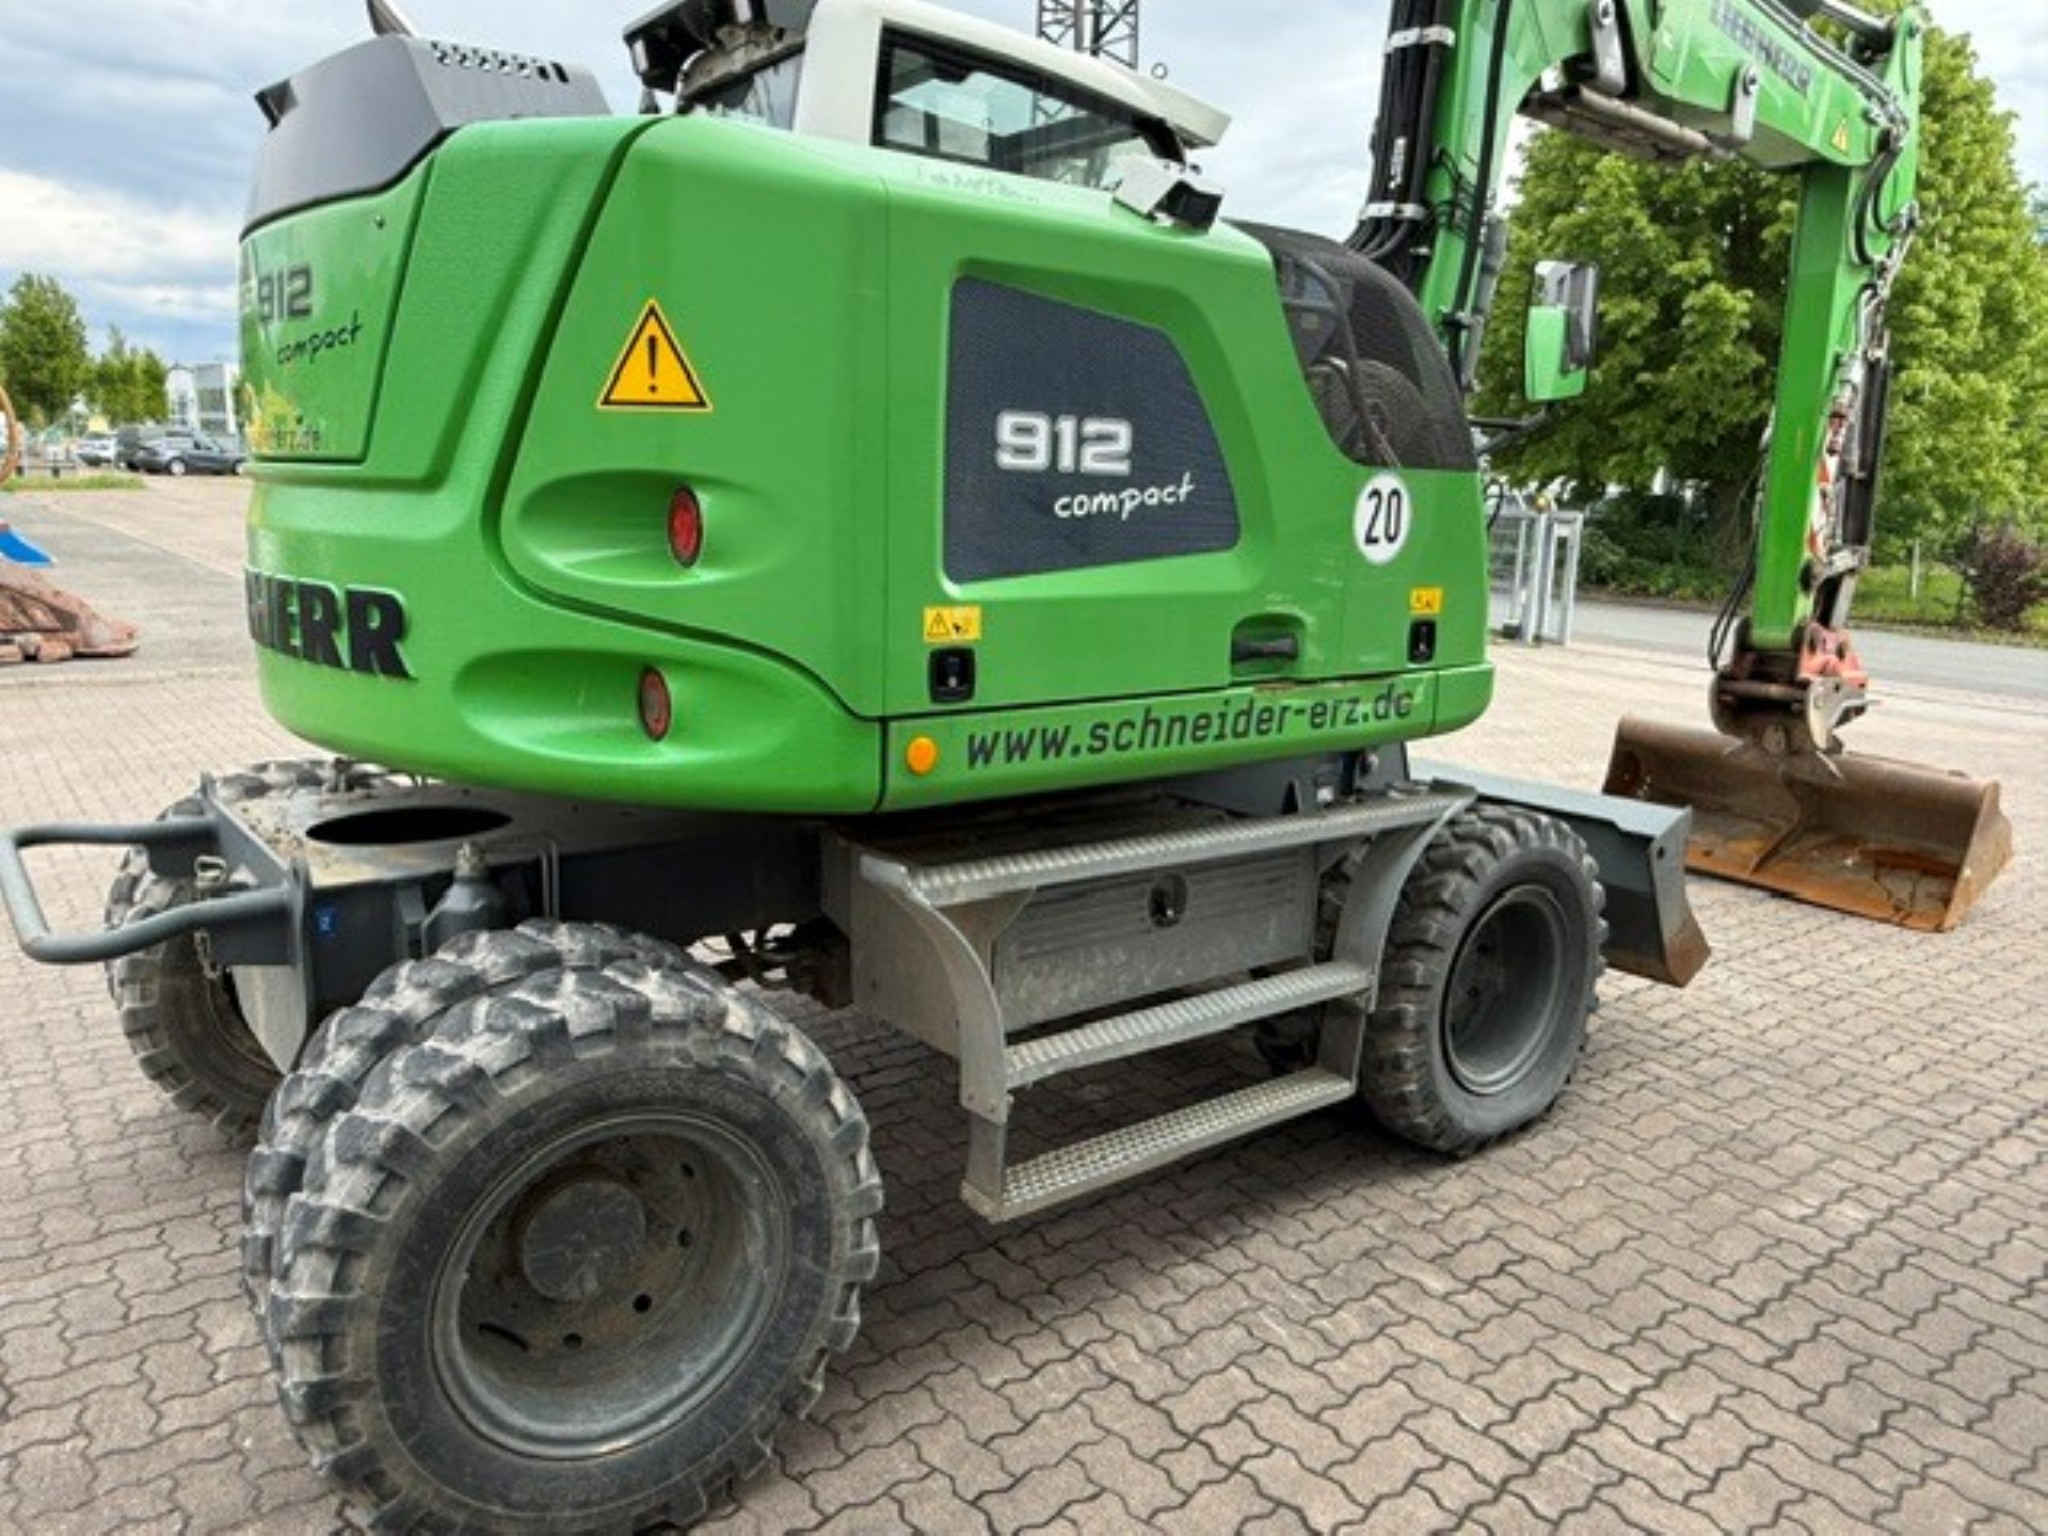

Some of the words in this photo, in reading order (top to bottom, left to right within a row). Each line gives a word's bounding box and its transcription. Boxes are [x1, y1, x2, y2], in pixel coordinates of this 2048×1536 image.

[258, 265, 313, 323] 912
[277, 310, 362, 363] compact
[996, 411, 1134, 477] 912
[1054, 471, 1195, 521] compact
[1365, 487, 1402, 545] 20
[967, 684, 1415, 770] www.schneider-erz.de
